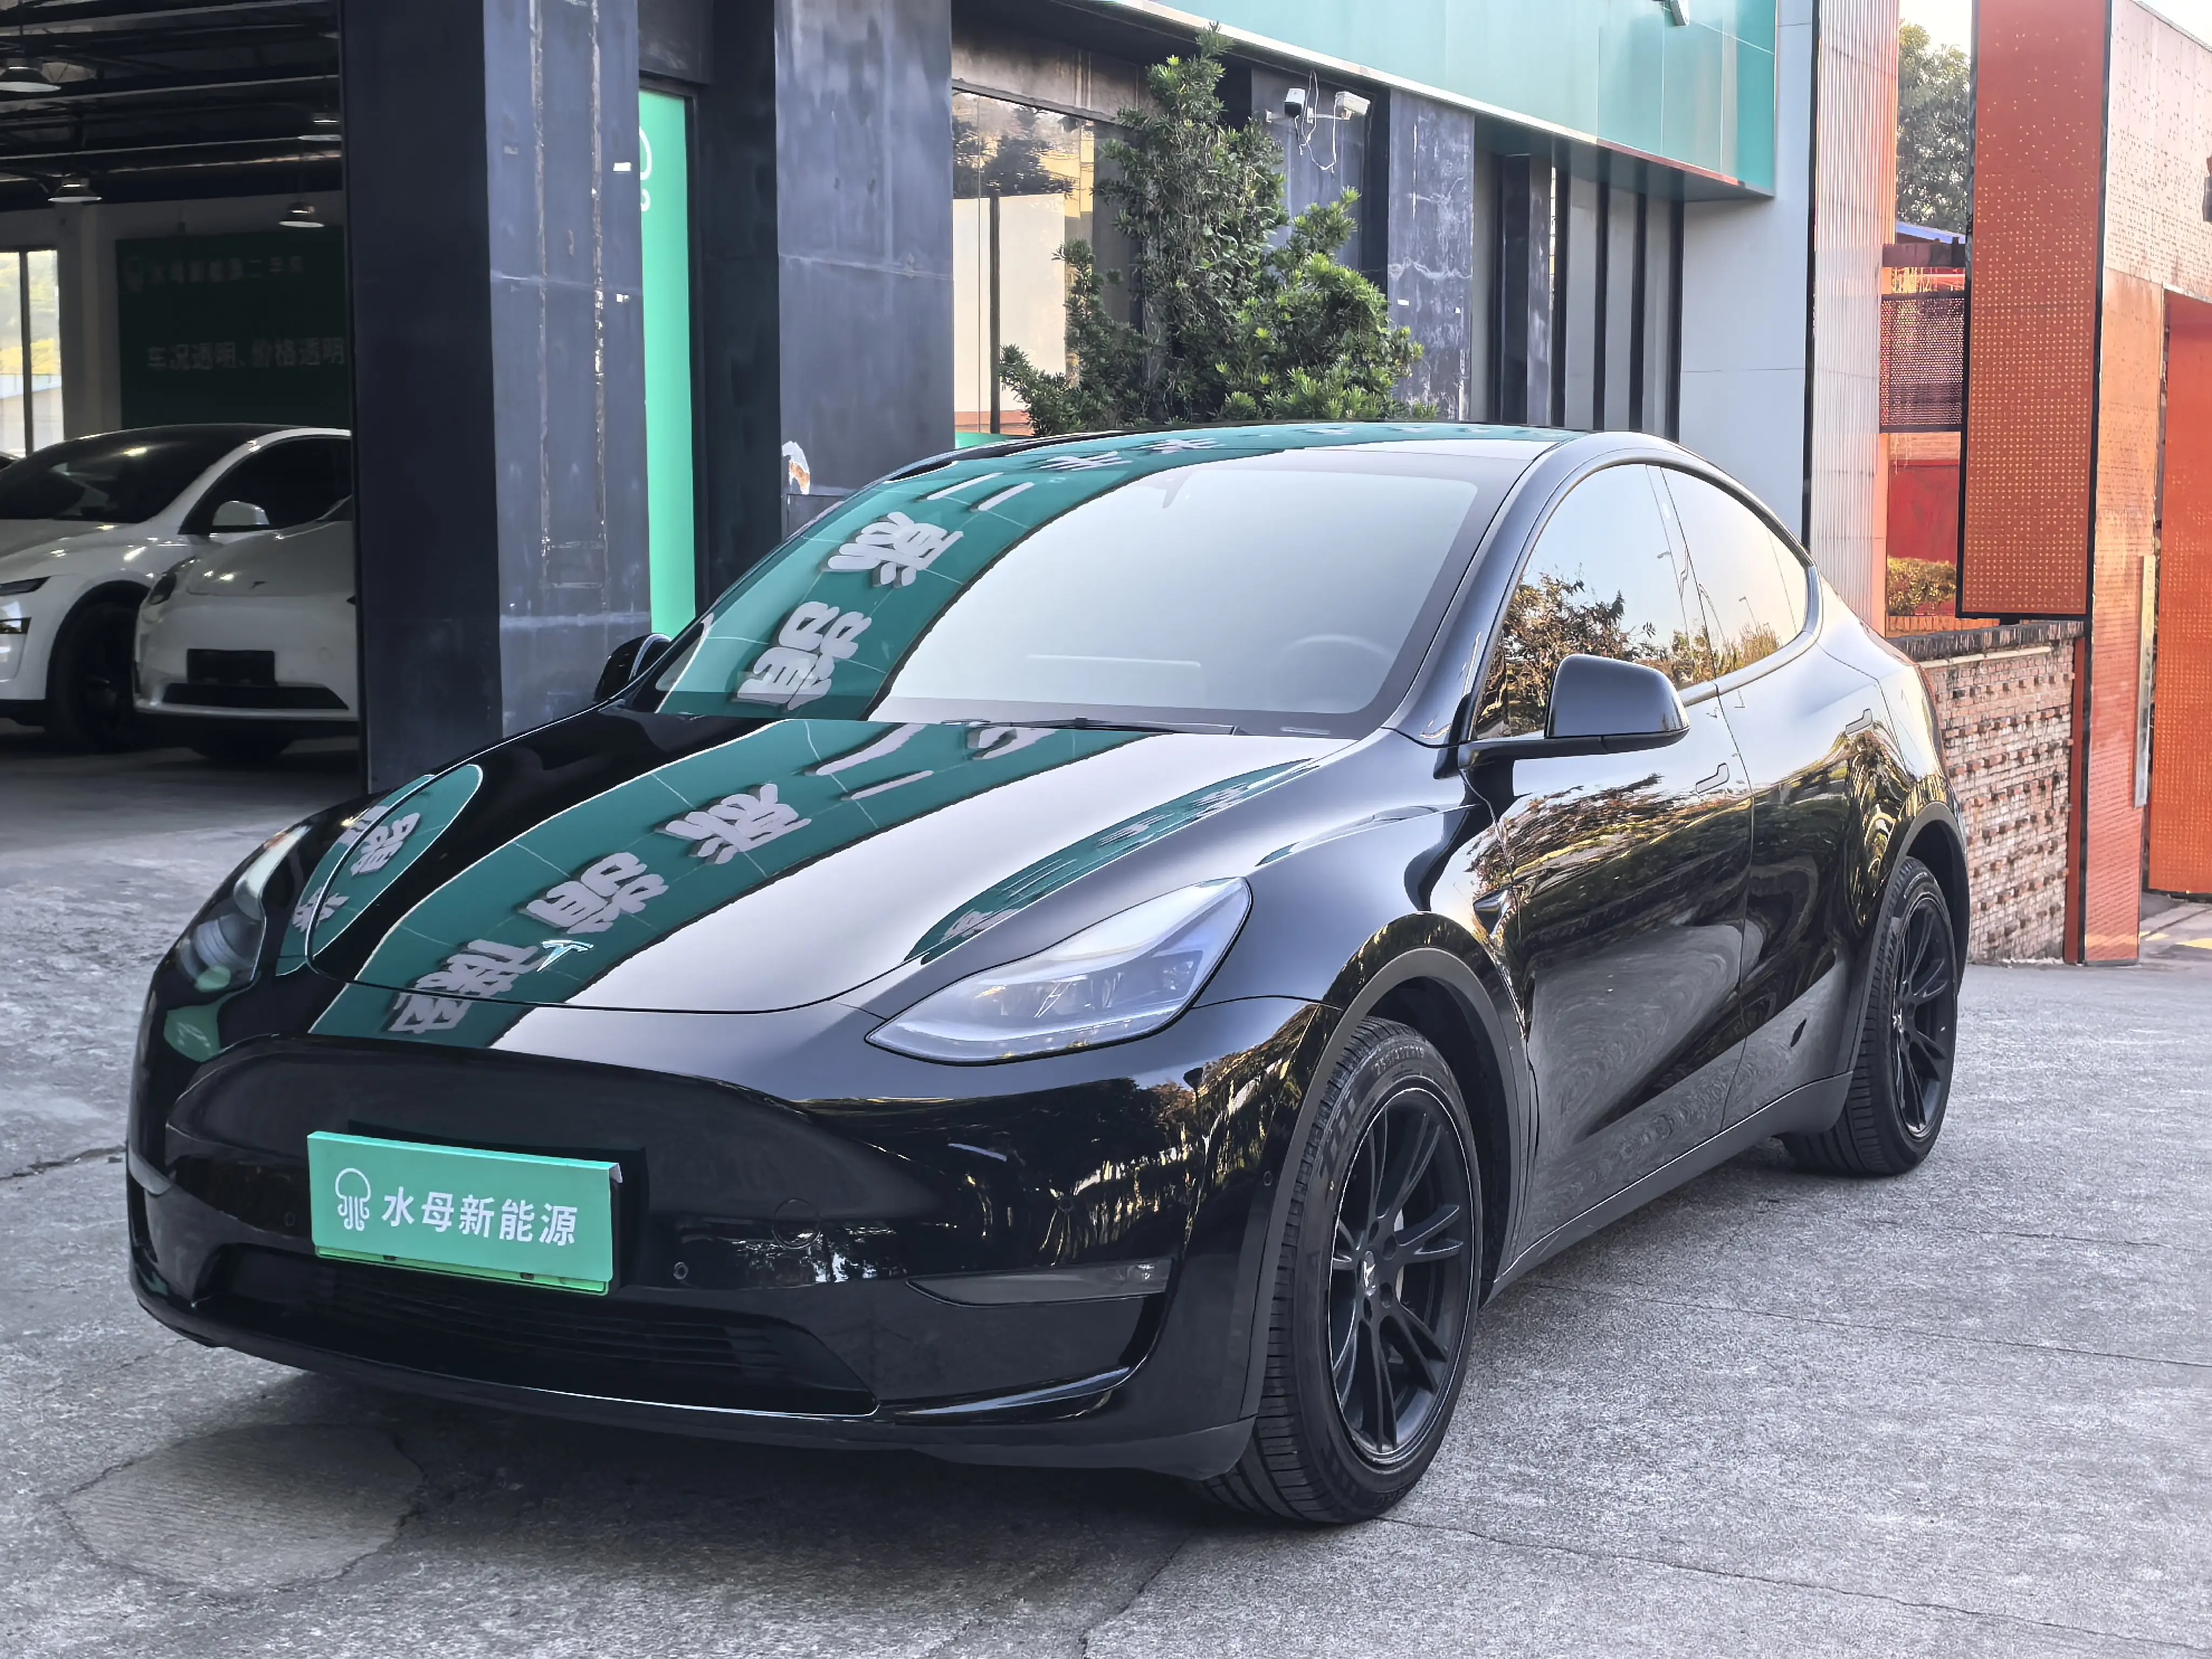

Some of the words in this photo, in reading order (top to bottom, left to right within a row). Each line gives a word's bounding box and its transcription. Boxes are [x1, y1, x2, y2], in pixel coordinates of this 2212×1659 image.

[381, 1186, 578, 1246] 水母新能源
